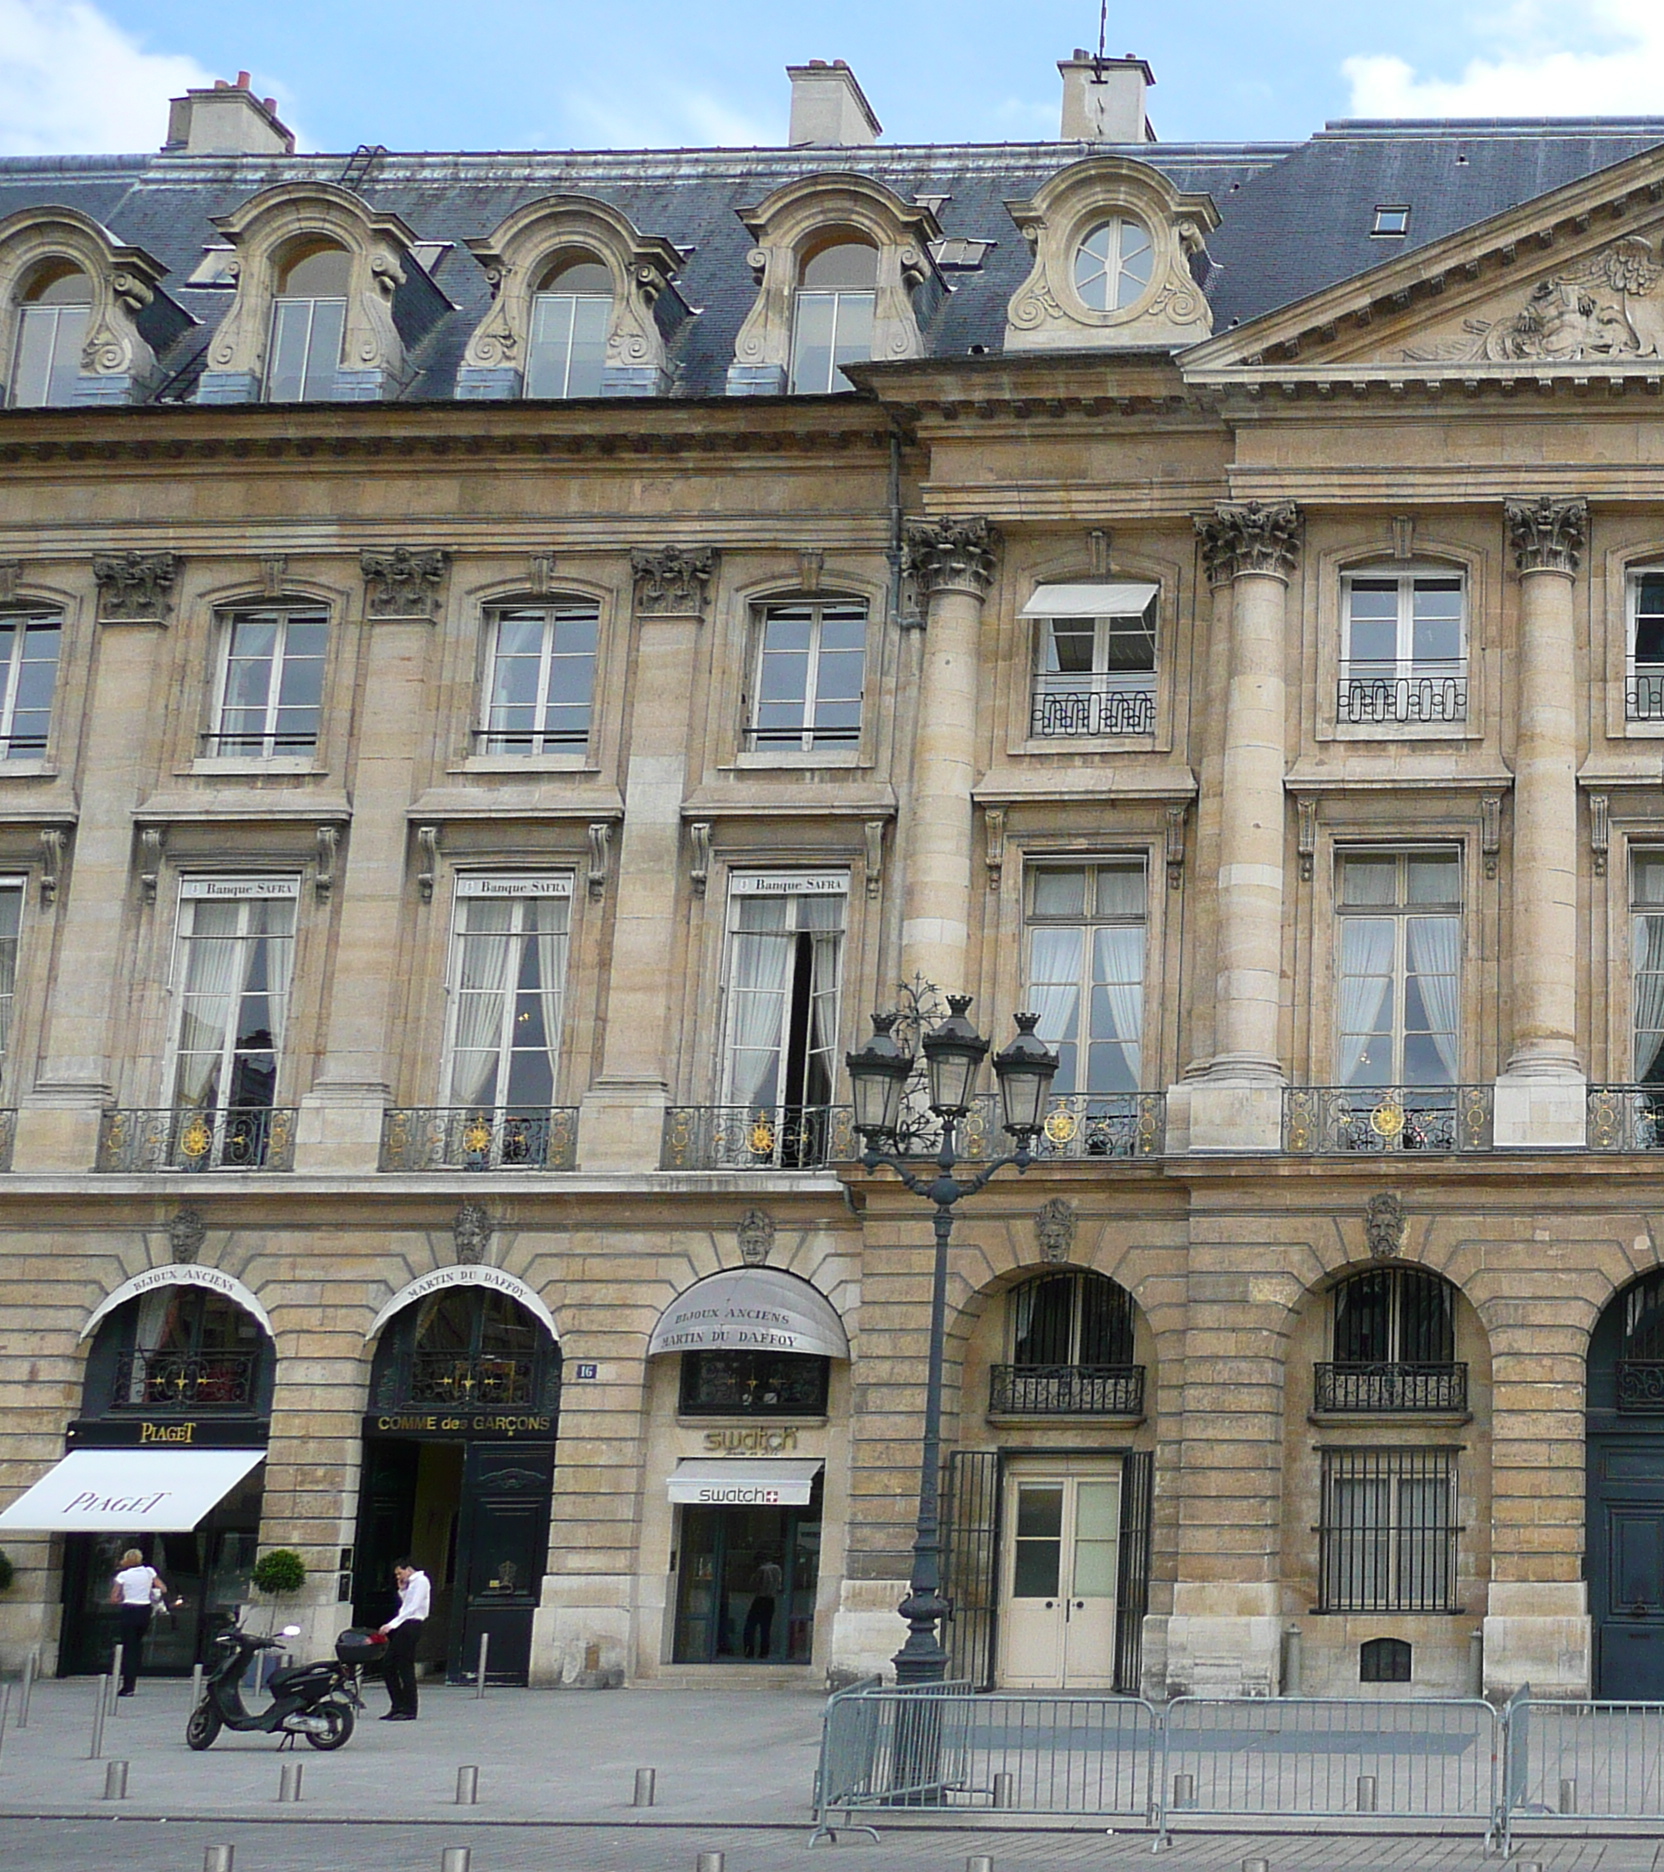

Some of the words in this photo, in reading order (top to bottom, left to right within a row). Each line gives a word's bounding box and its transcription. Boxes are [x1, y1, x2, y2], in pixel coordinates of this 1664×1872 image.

[206, 882, 253, 897] Banque
[481, 880, 527, 895] Banque
[755, 878, 802, 893] Banque
[133, 1269, 178, 1292] BIJOUX
[183, 1269, 236, 1293] ANCIENS
[408, 1271, 454, 1299] MARTIN
[460, 1270, 478, 1281] DU
[484, 1272, 528, 1299] DAFFOY
[675, 1308, 720, 1325] BIJOUX
[724, 1307, 790, 1325] ANCIENS
[660, 1331, 705, 1348] MARTIN
[711, 1331, 730, 1343] DU
[738, 1330, 799, 1348] DAFFOY
[579, 1365, 594, 1378] 16
[139, 1422, 197, 1443] PIAGET
[377, 1416, 437, 1431] COMME
[441, 1416, 467, 1431] des
[472, 1416, 551, 1437] GARÇONS
[703, 1427, 799, 1451] swatch
[61, 1491, 173, 1514] PIAGET
[699, 1487, 765, 1503] swatch
